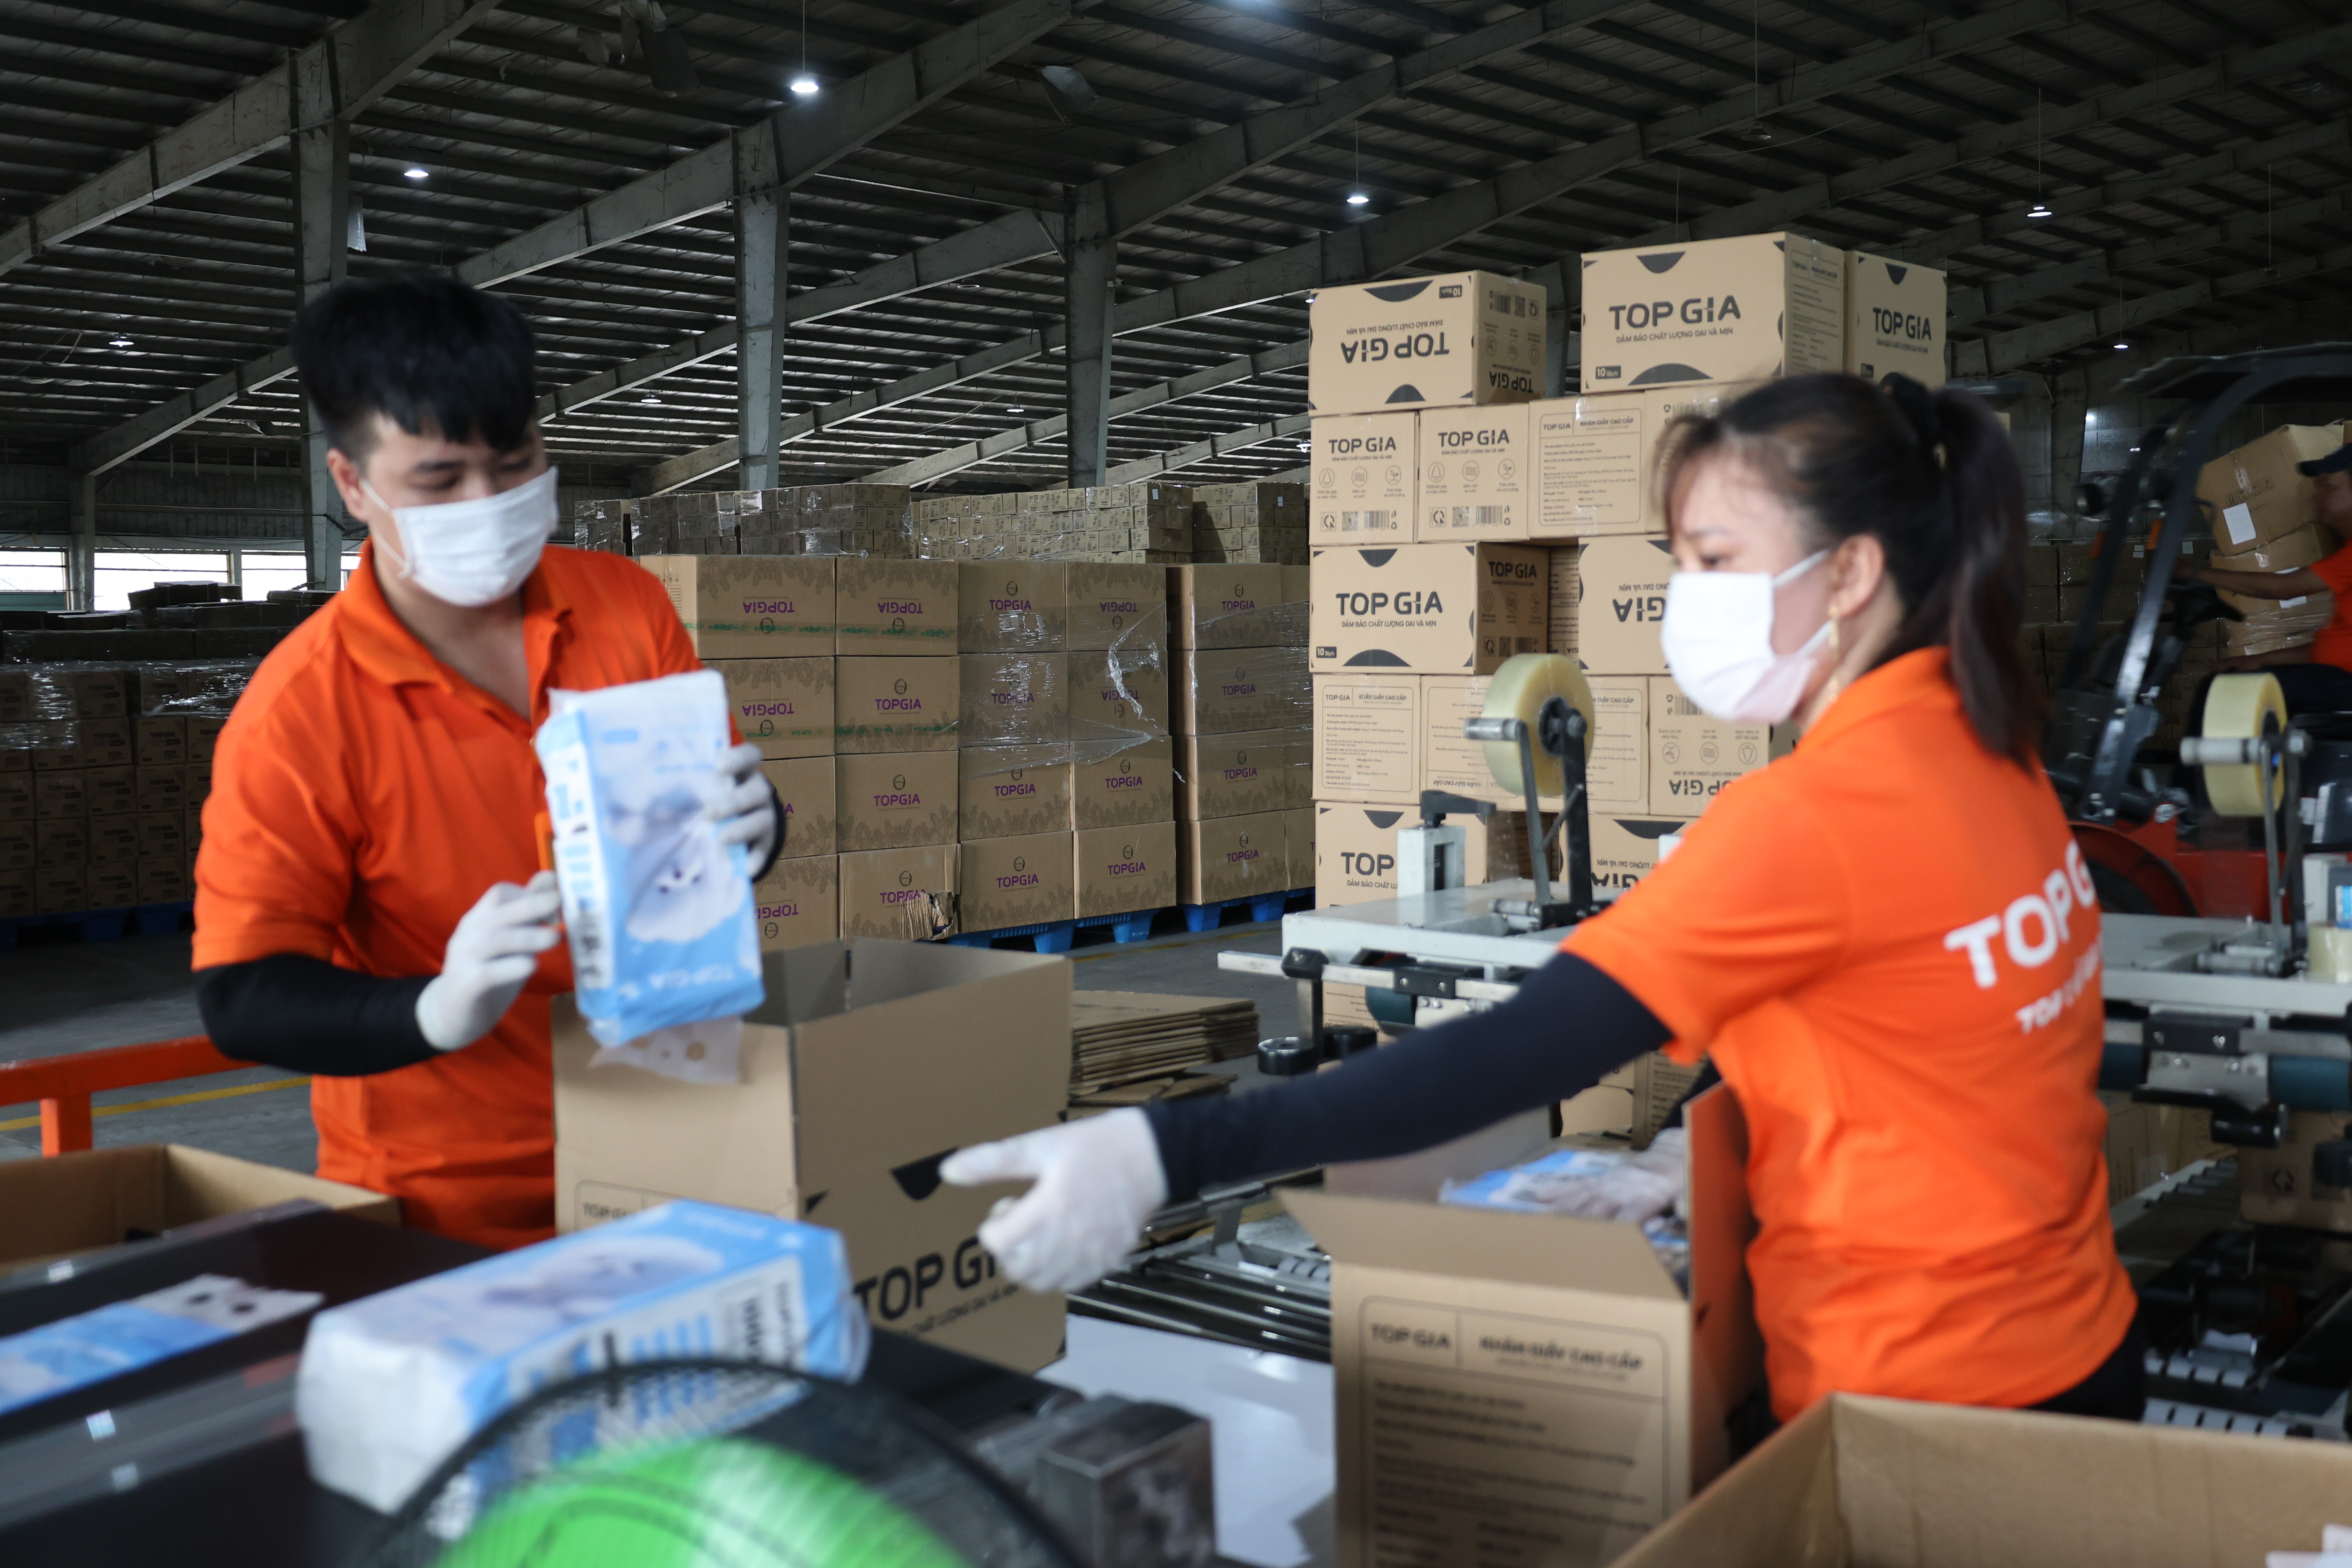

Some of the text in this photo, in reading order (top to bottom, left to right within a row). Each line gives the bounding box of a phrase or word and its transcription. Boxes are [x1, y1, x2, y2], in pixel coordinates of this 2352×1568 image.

[1453, 287, 1461, 296] 10
[1609, 295, 1741, 330] TOP GIA
[1873, 307, 1931, 340] TOP GIA
[1341, 332, 1449, 364] TOP GIA
[1596, 367, 1606, 377] 10
[1489, 372, 1533, 393] TOP GIA
[1438, 429, 1509, 446] TOP GIA
[1328, 436, 1396, 454] TOP GIA
[1488, 561, 1537, 579] TOP GIA
[742, 601, 795, 614] TOPGIA
[877, 602, 923, 614] TOPGIA
[989, 600, 1032, 611] TOPGIA
[1100, 602, 1138, 612] TOPGIA
[1221, 600, 1255, 611] TOPGIA
[1336, 591, 1443, 615] TOP GIA
[1613, 597, 1666, 622] GIA
[1101, 690, 1140, 701] TOGIA
[1222, 684, 1256, 695] TOPGIA
[875, 699, 922, 711] TOPGIA
[992, 693, 1034, 704] TOPGIA
[742, 703, 795, 717] TOPGIA
[1224, 767, 1258, 780] TOPGIA
[1105, 775, 1143, 789] TOPGIA
[1669, 780, 1703, 795] GIA
[994, 784, 1036, 797] TOPGIA
[873, 793, 920, 807] TOPGIA
[1226, 849, 1259, 863] TOPGIA
[1107, 861, 1146, 875] TOPGIA
[1341, 852, 1394, 876] TOP
[996, 874, 1039, 888] TOPGIA
[757, 904, 799, 920] TOPGI
[1943, 839, 2096, 989] TOPG
[853, 1251, 944, 1321] TOP
[953, 1234, 996, 1290] GI
